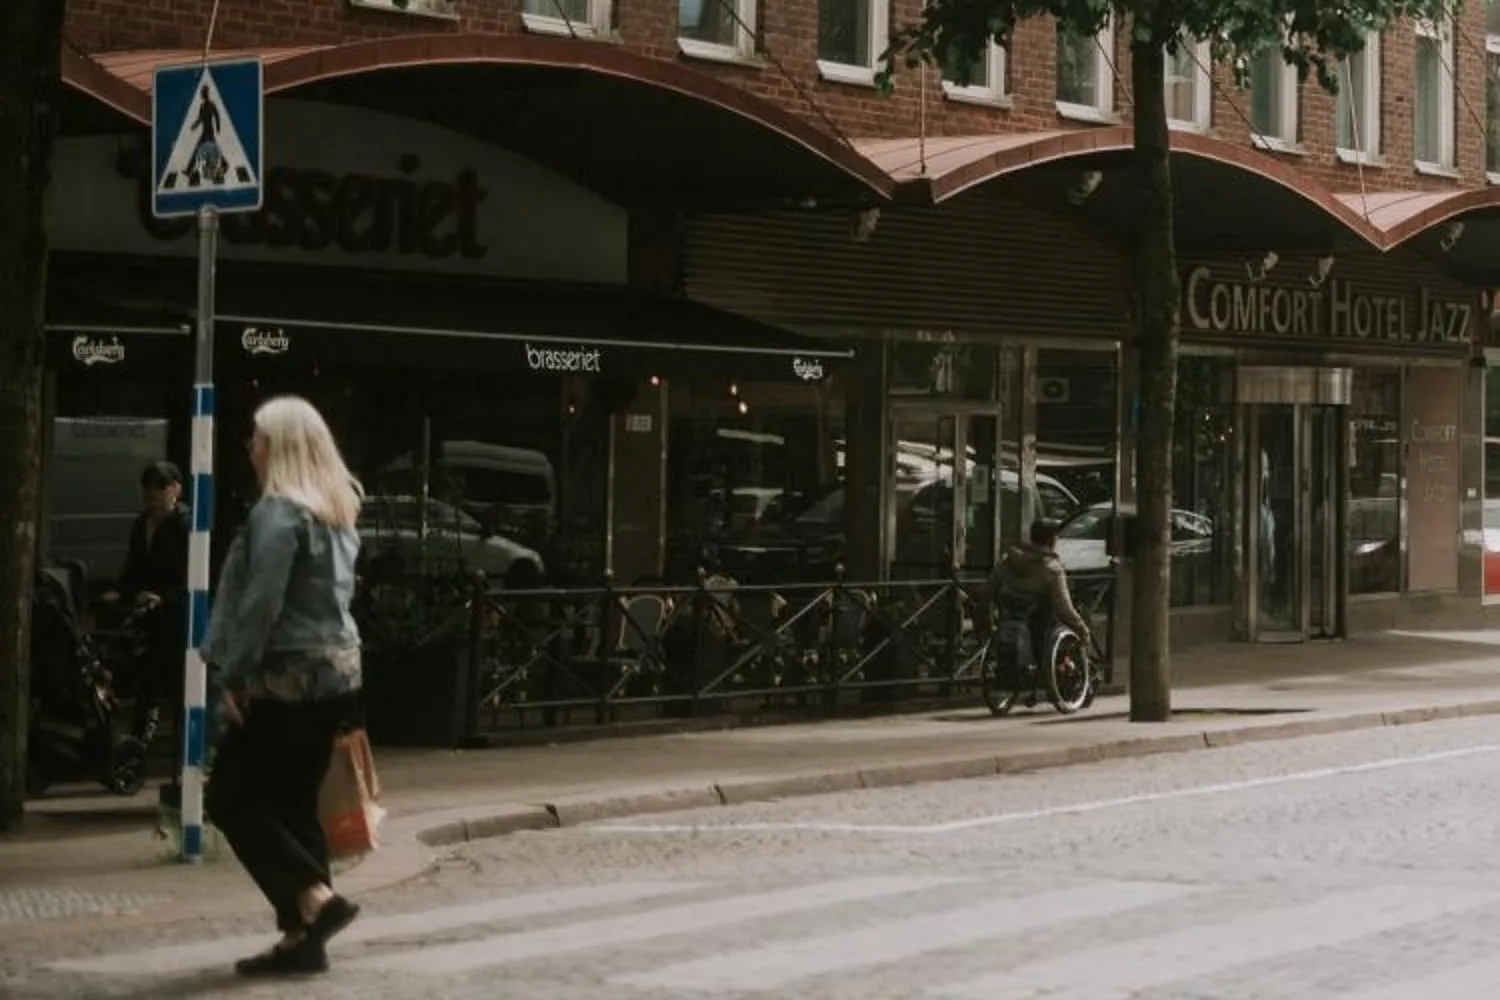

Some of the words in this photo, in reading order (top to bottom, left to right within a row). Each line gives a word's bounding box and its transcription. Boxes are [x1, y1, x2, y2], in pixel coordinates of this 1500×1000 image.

[1330, 279, 1411, 343] HOTEL
[1417, 287, 1471, 345] JAZZ
[525, 342, 602, 373] brasseriet
